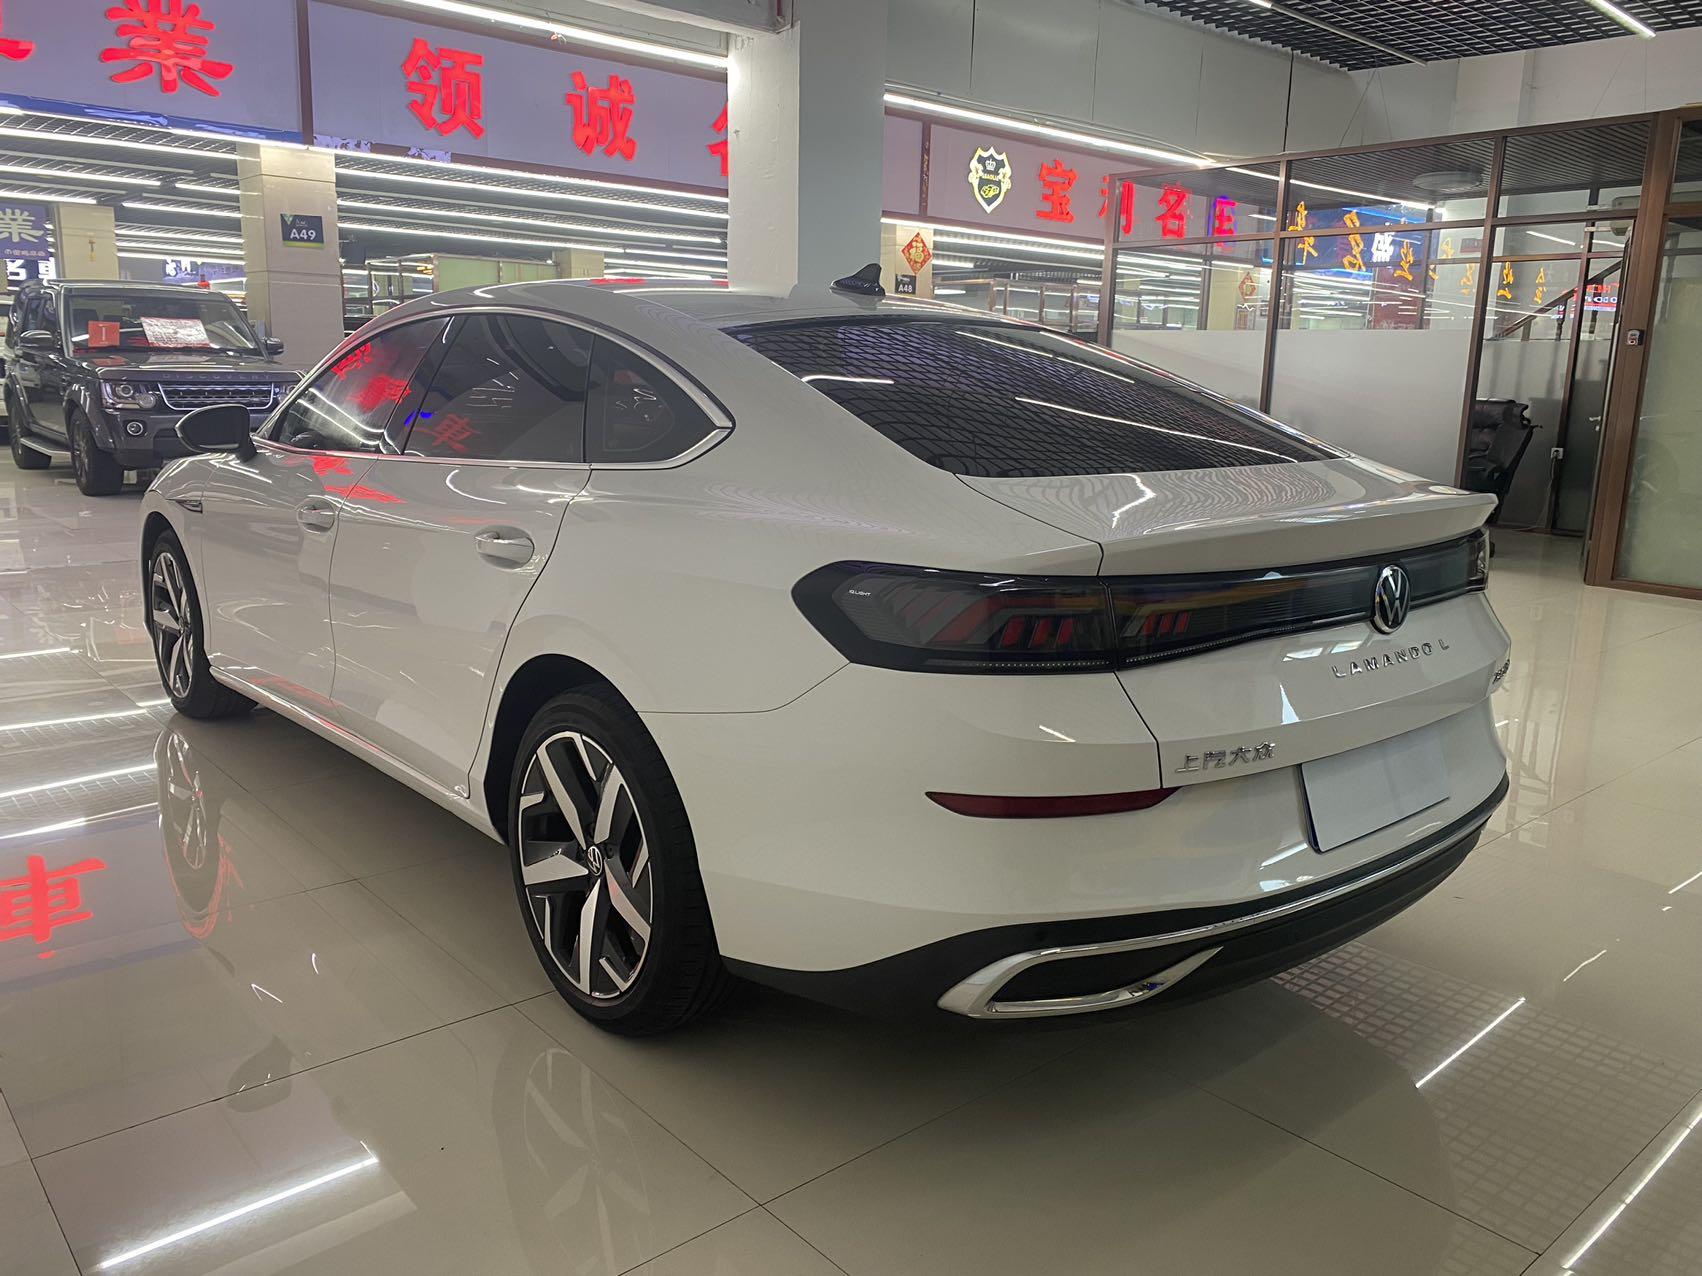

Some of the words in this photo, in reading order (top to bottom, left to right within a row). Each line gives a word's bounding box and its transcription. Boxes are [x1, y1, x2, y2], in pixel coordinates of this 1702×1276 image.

[290, 228, 316, 240] A49
[898, 284, 913, 293] A48
[1331, 642, 1433, 678] LAMANDO
[1438, 638, 1450, 651] L
[1175, 741, 1276, 773] 上汽大众
